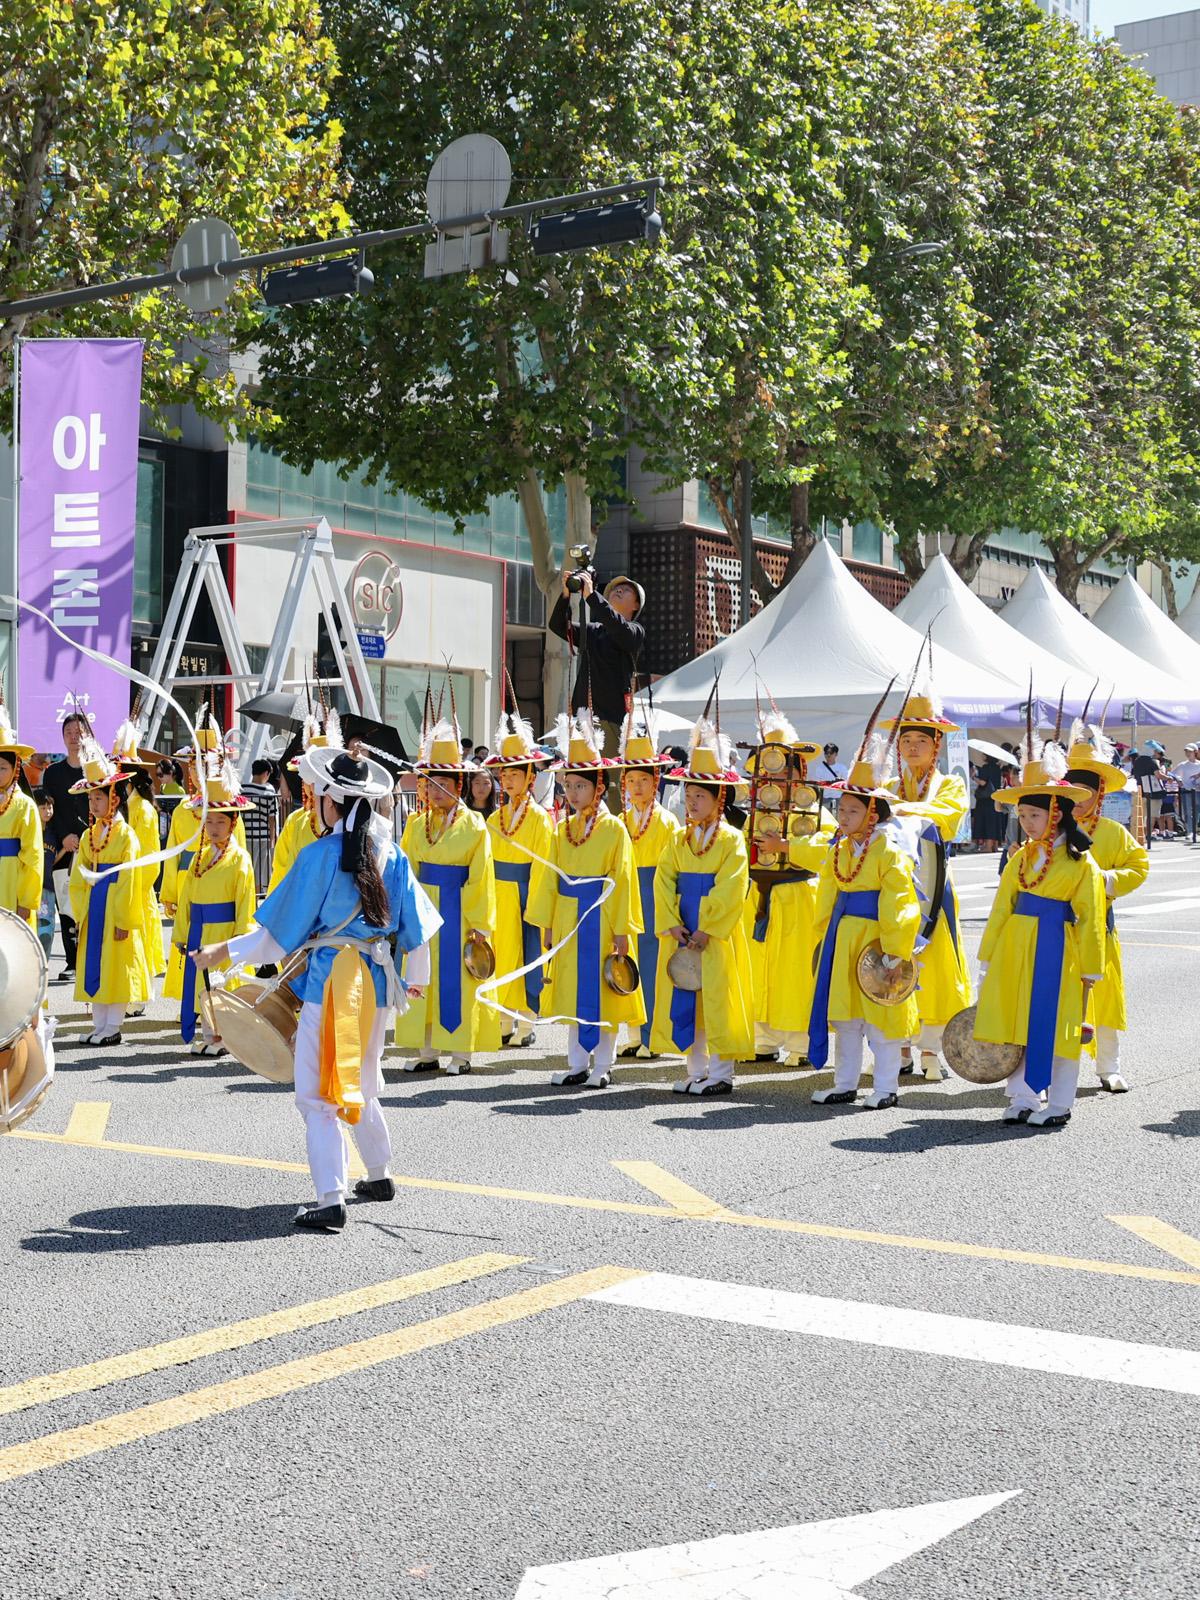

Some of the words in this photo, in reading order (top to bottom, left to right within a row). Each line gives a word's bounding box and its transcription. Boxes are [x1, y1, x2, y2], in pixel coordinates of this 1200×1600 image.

[51, 412, 107, 627] 아트존
[360, 583, 394, 612] SIC
[178, 655, 207, 673] 환빌딩
[62, 691, 91, 706] Art
[55, 708, 97, 723] Ze
